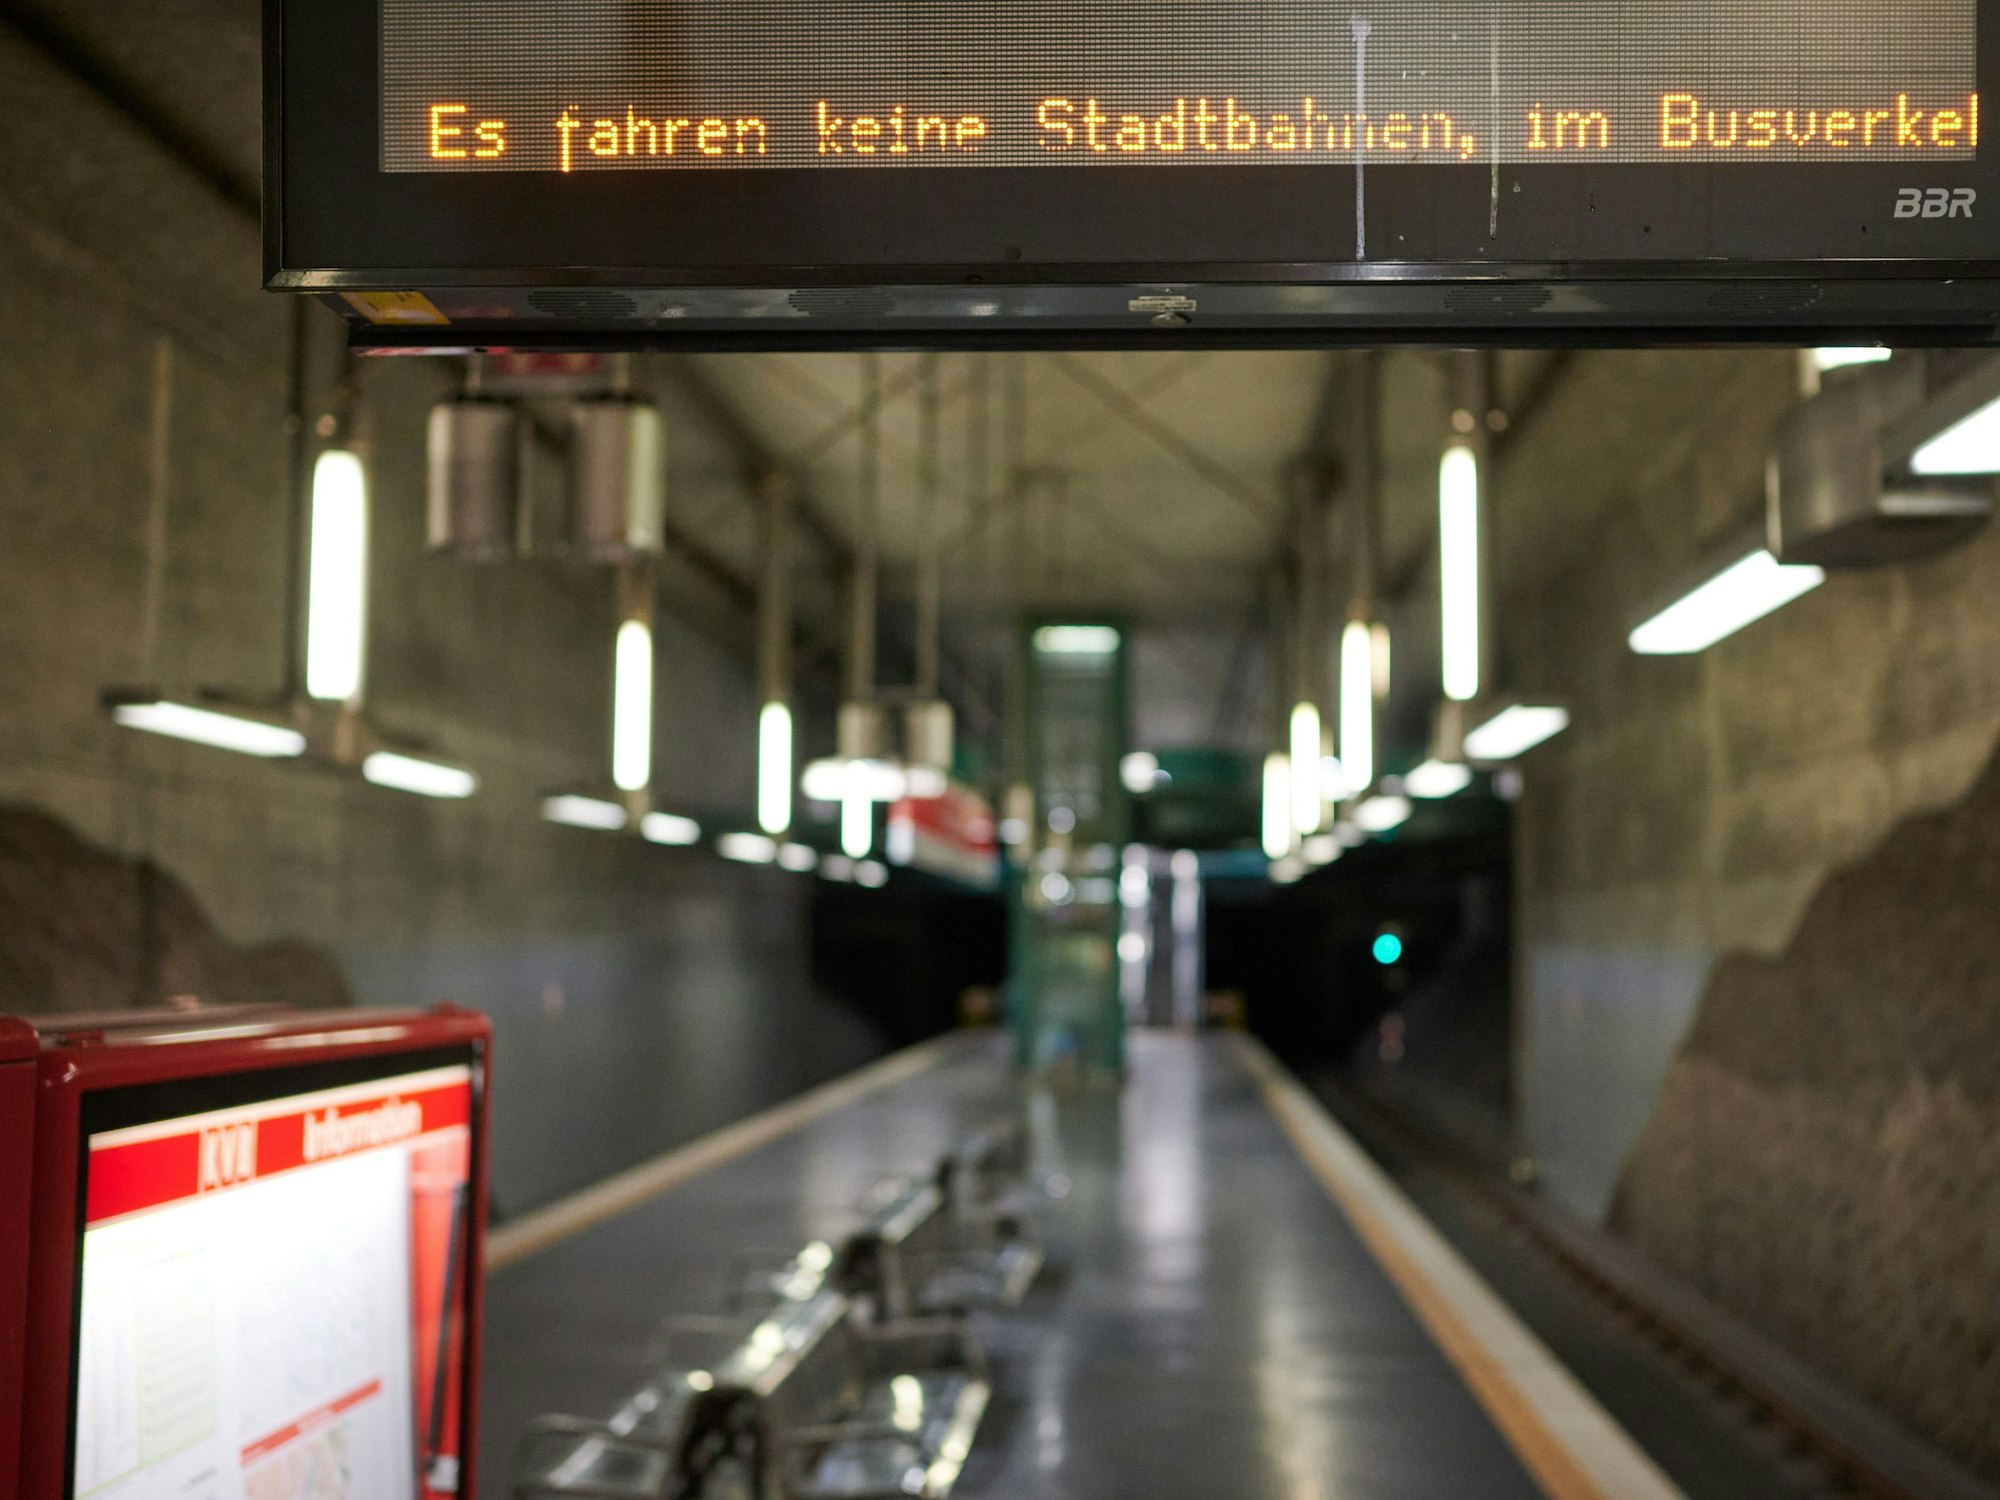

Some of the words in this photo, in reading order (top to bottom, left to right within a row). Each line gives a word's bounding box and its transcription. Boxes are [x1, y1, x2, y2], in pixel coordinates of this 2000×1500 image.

[428, 104, 507, 159] Es
[556, 105, 768, 172] fahren
[816, 101, 988, 155] keine
[1036, 97, 1475, 159] Stadtbahnen,
[1527, 103, 1610, 149] im
[1659, 93, 1977, 148] Busverke
[1894, 188, 1977, 218] BBR
